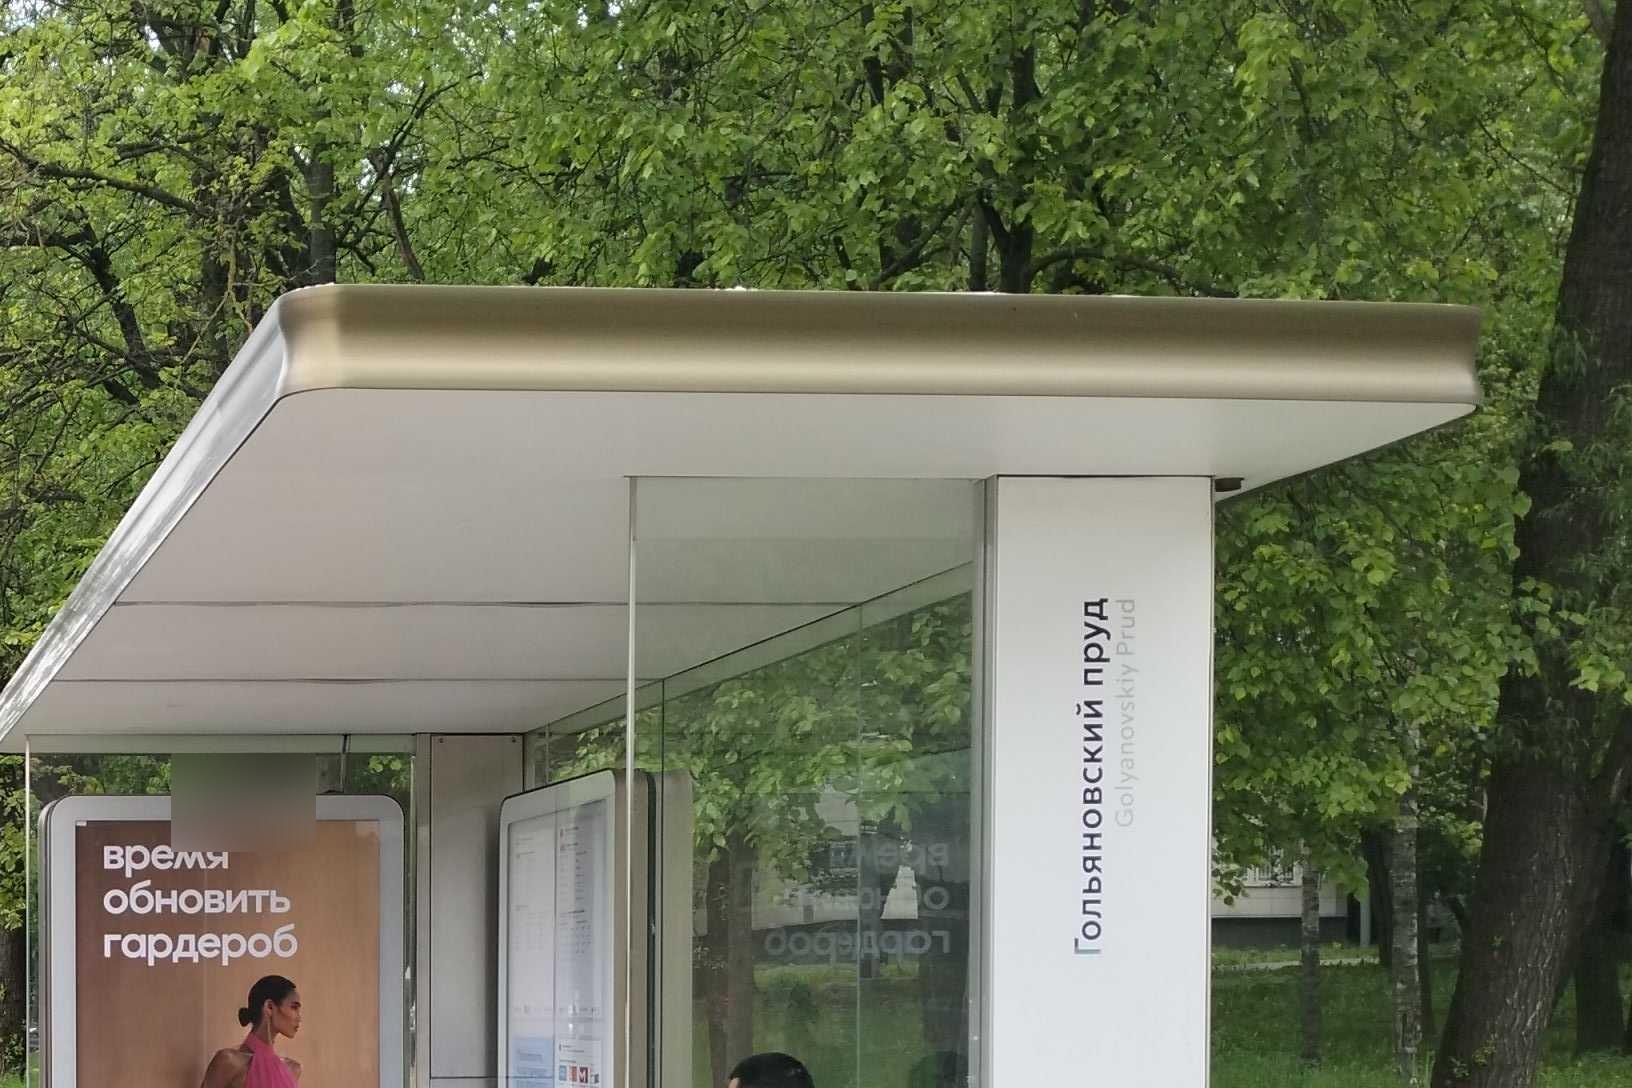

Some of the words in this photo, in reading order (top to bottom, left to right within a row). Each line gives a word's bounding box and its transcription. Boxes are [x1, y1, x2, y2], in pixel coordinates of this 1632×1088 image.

[1084, 598, 1111, 686] пруд
[1115, 599, 1136, 656] Prud
[1114, 663, 1140, 828] Golyanovskiy
[1074, 700, 1104, 955] Гольяновский
[103, 844, 229, 878] время
[103, 879, 291, 914] обновить
[103, 923, 298, 966] гардероб
